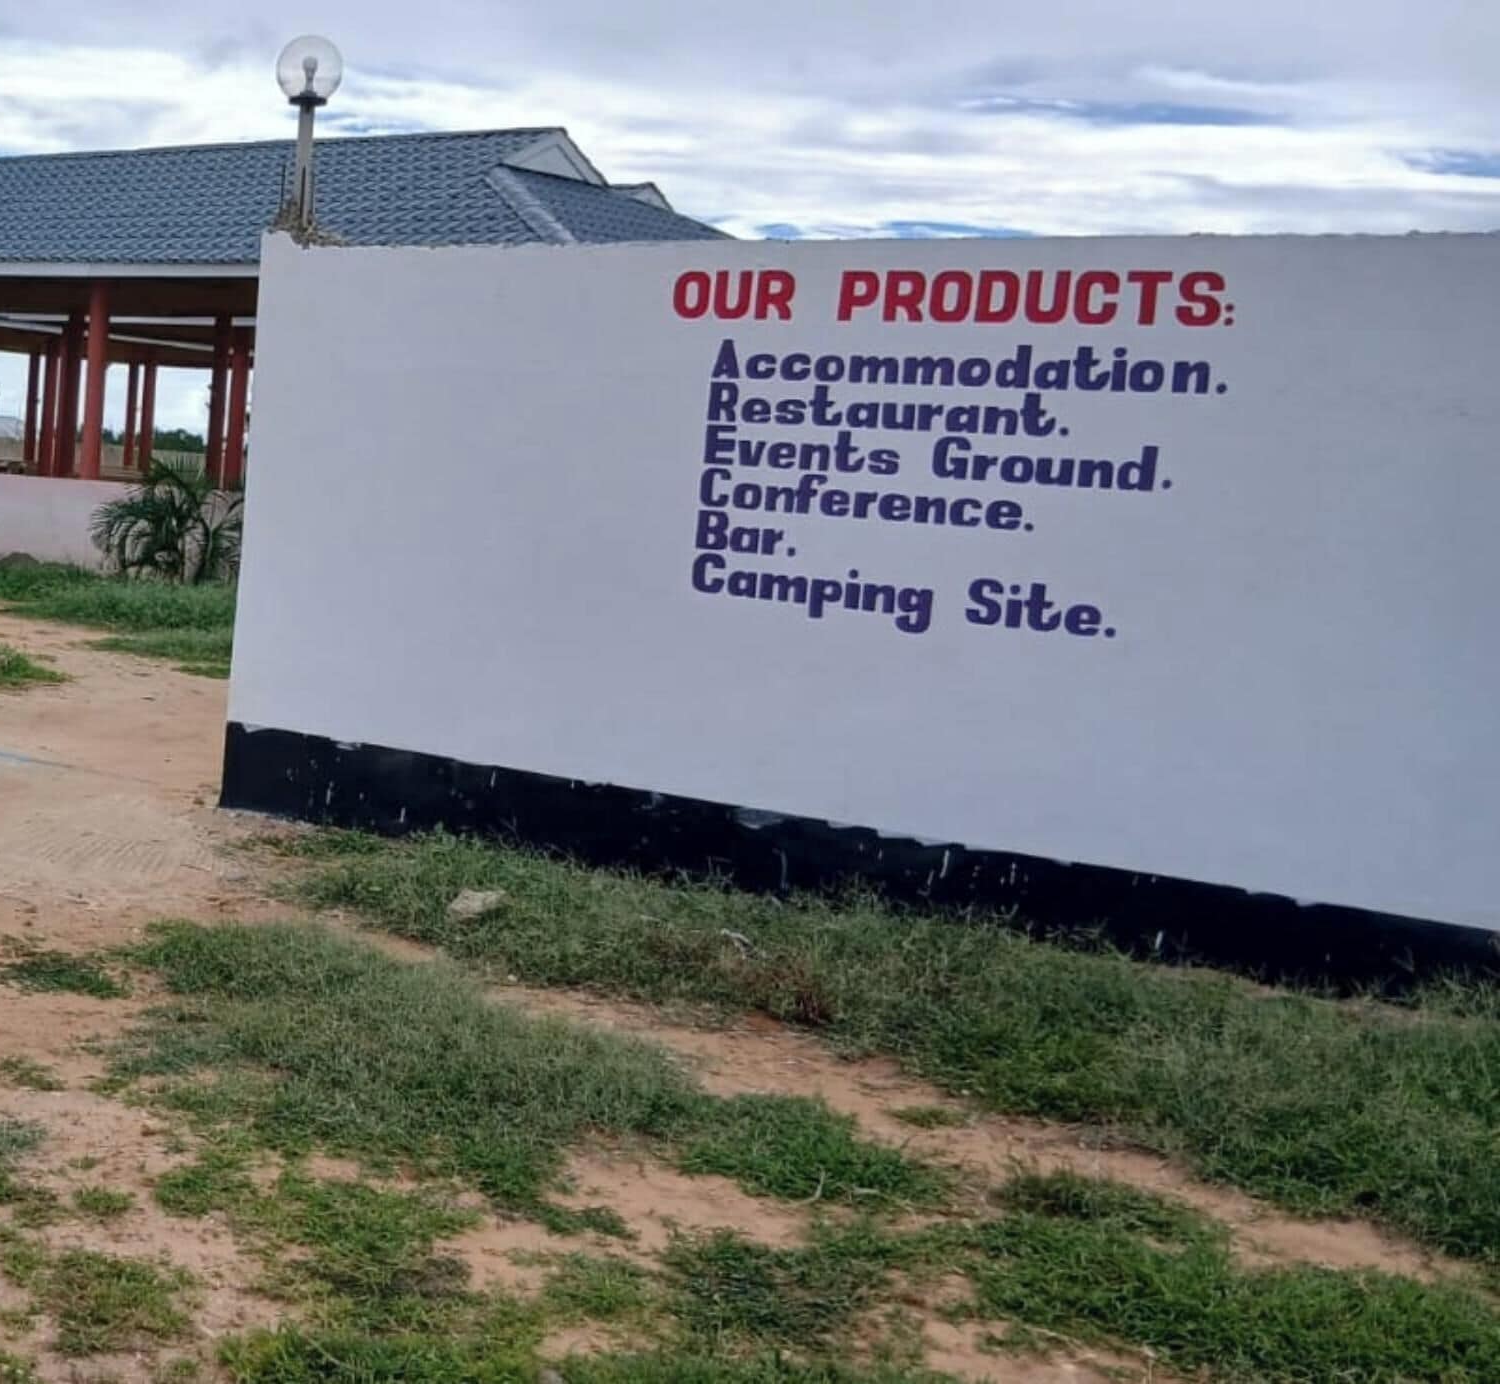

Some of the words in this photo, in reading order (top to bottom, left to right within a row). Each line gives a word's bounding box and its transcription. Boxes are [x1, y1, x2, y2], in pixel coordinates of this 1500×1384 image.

[672, 269, 797, 322] OUR
[837, 269, 1236, 328] PRODUCTS:
[710, 337, 1229, 396] Accommodation.
[706, 381, 1071, 439] Restaurant.
[702, 423, 901, 477] Events
[930, 434, 1174, 493] Ground.
[698, 466, 1035, 533] Conference.
[694, 508, 797, 558] Bar.
[690, 551, 935, 635] Camping
[964, 577, 1118, 639] Site.
